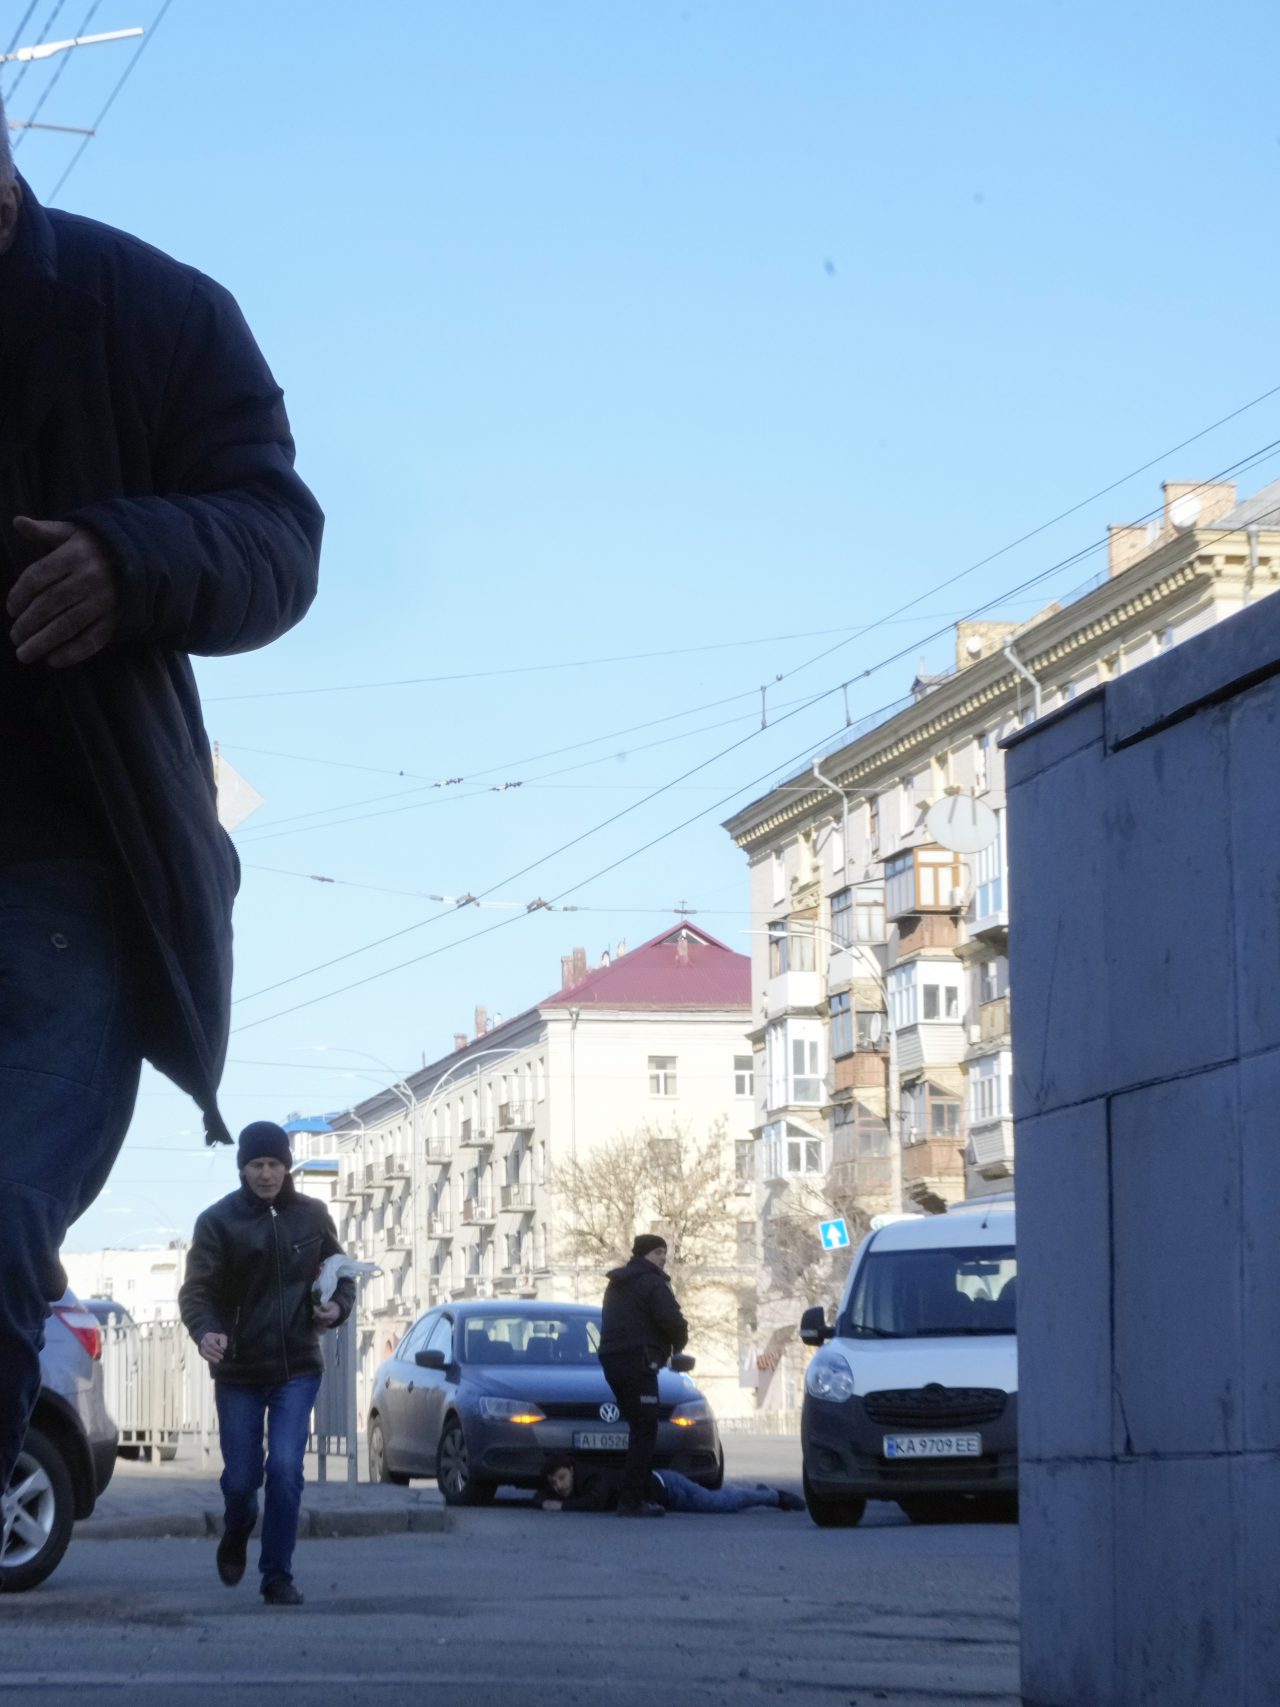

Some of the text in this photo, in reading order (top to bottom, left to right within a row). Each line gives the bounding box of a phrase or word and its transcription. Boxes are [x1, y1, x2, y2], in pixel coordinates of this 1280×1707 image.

[895, 1438, 979, 1454] KA 9709 EE
